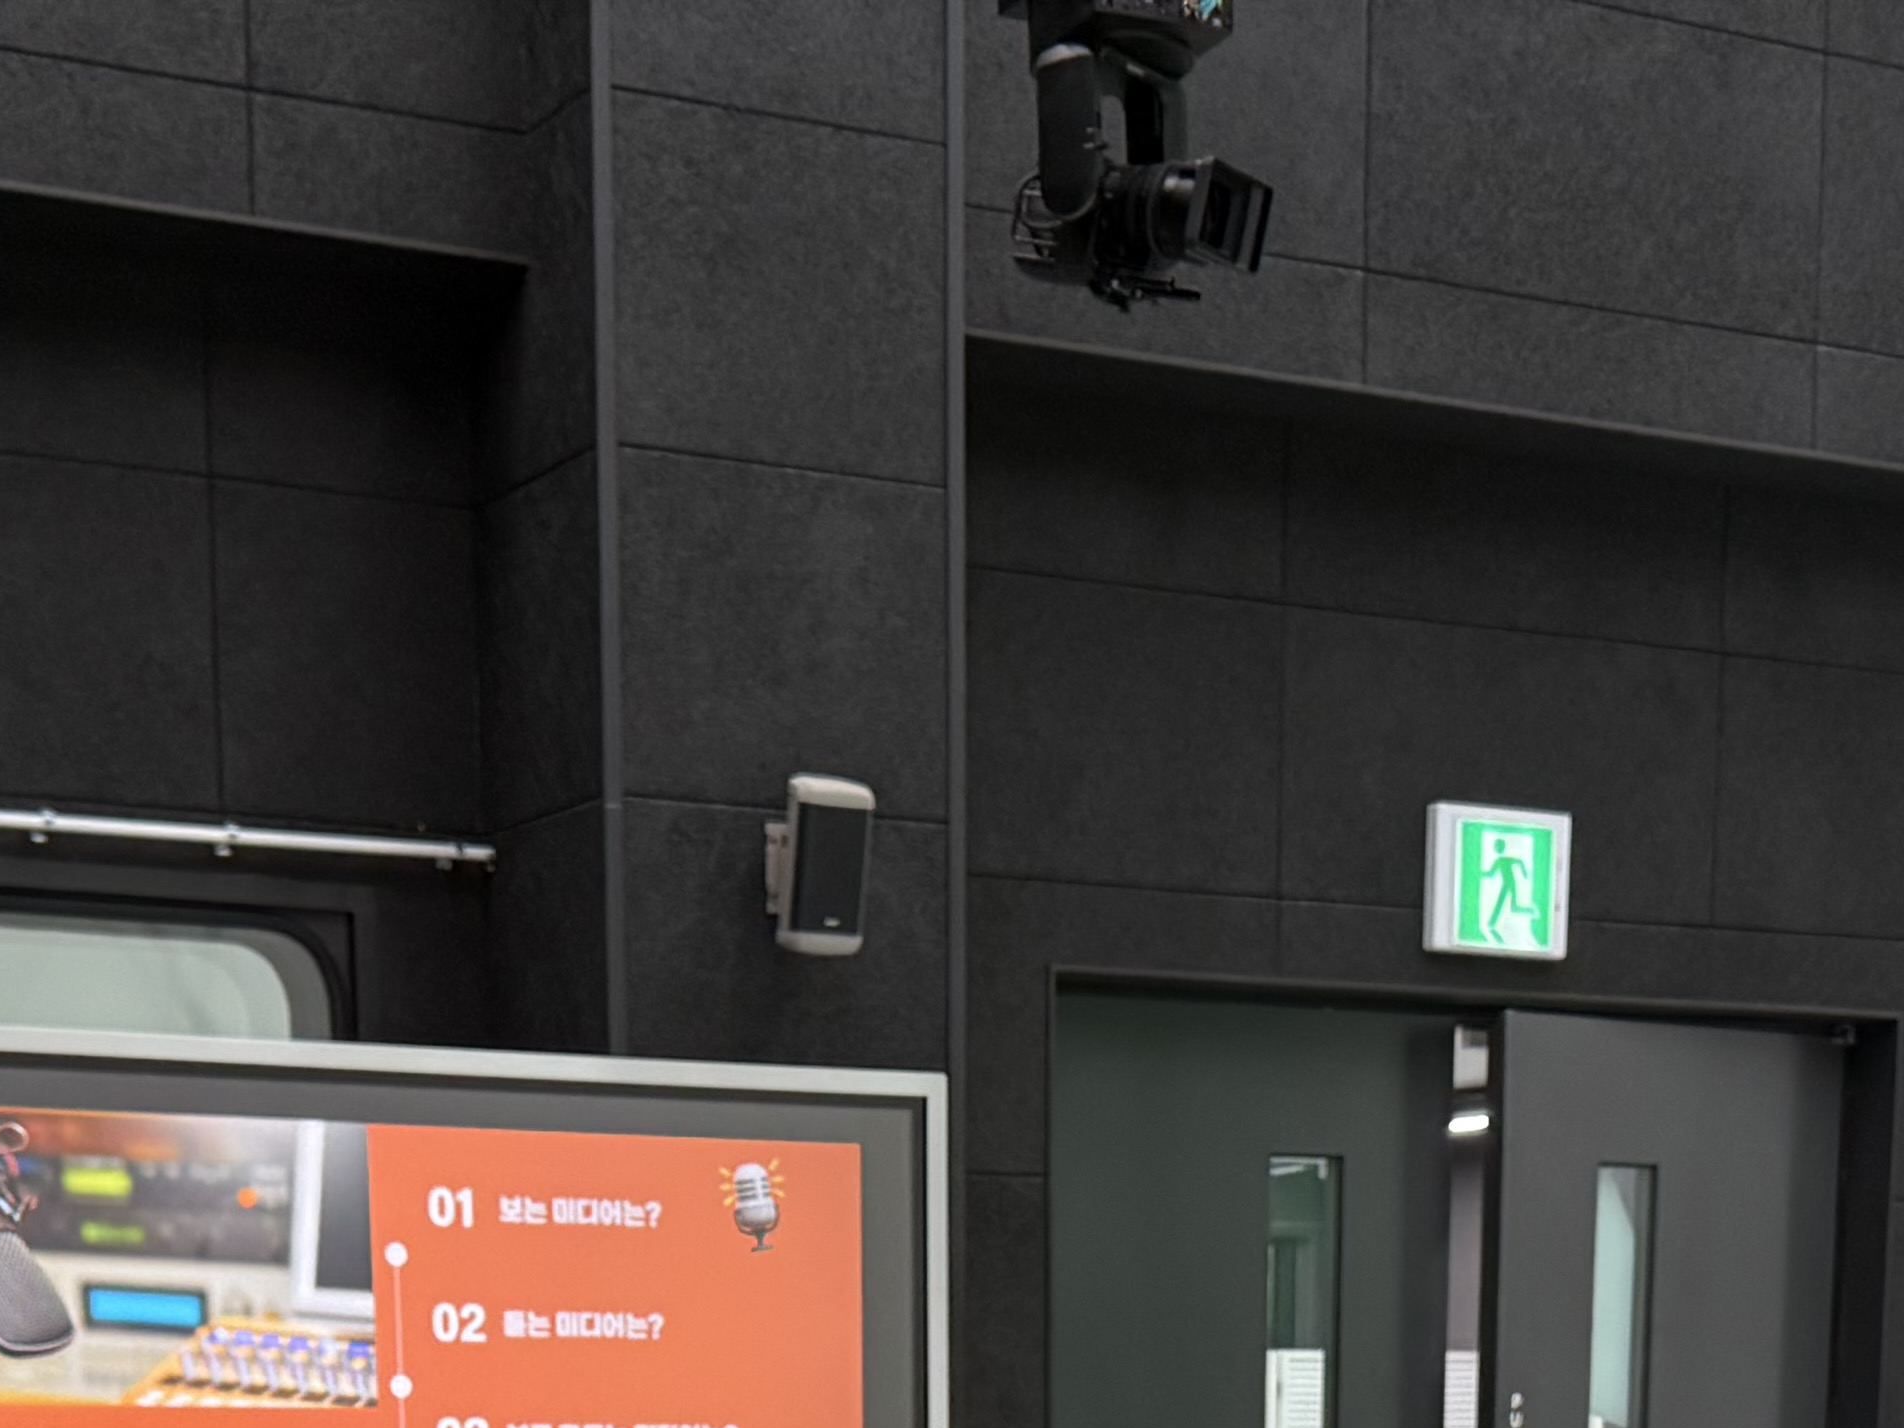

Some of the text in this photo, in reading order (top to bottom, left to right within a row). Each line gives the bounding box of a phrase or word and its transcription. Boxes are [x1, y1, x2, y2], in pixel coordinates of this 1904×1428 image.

[428, 1187, 662, 1228] 01 보는 미디어는?
[432, 1303, 487, 1343] 02
[556, 1311, 664, 1341] 미디어는?
